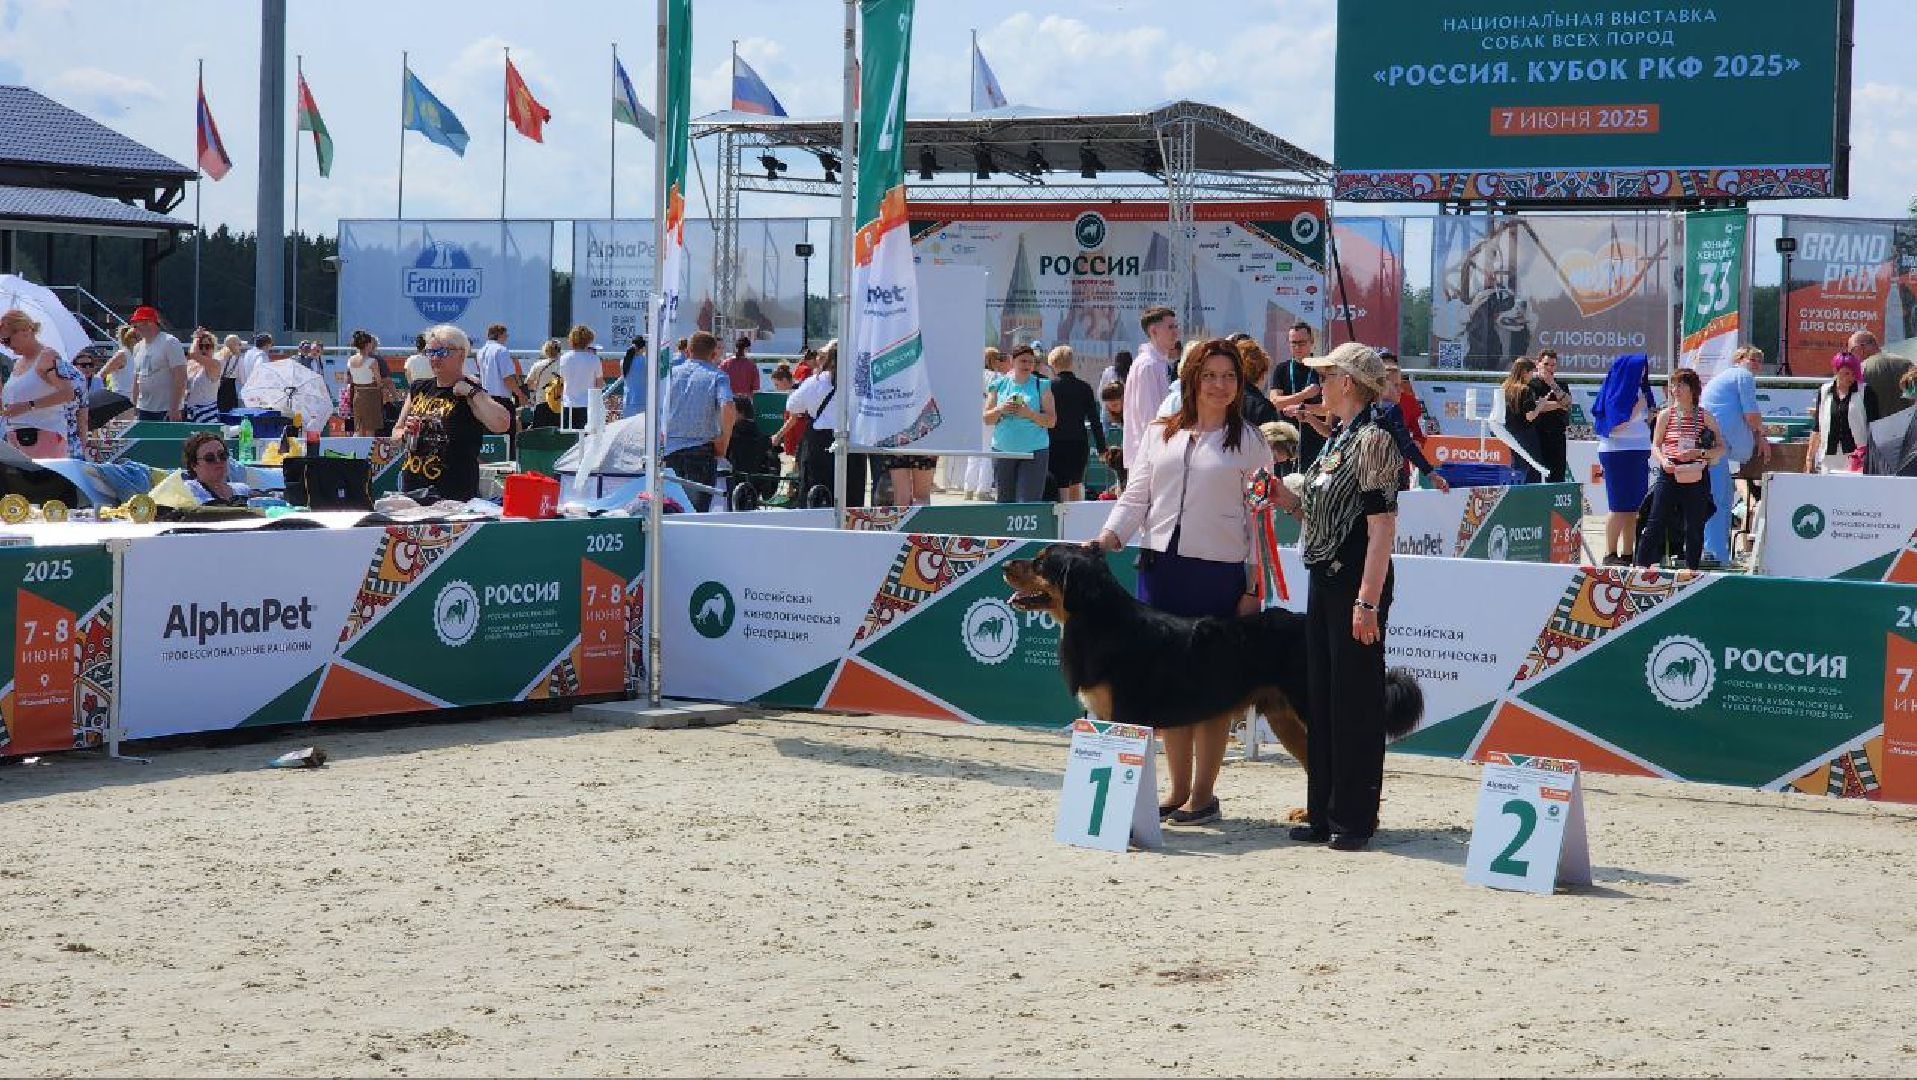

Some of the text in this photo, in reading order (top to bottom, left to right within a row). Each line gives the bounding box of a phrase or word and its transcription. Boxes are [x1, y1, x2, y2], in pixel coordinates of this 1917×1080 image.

[1444, 9, 1717, 31] НАЦИОНАЛЬНАЯ ВЫСТАВКА
[1481, 31, 1675, 49] СОБАК ВСЕХ ПОРОД
[1373, 54, 1801, 86] «РОССИЯ. КУБОК РКФ 2025»
[1502, 109, 1648, 128] 7 ИЮНЯ 2025
[587, 240, 656, 262] AlphaPe
[1801, 232, 1886, 262] GRAND
[1040, 256, 1139, 275] РОССИЯ
[408, 271, 477, 293] Farmina
[1822, 262, 1879, 292] PRIX
[1698, 260, 1731, 314] 33
[1800, 307, 1877, 321] СУХОЙ КОРМ
[1800, 321, 1868, 333] ДЛЯ СОБАК
[1538, 331, 1646, 347] С ЛЮБОВЬЮ
[1452, 449, 1500, 462] РОССИЯ
[1007, 515, 1037, 532] 2025
[587, 533, 624, 552] 2025
[23, 560, 73, 582] 2025
[484, 582, 560, 606] РОССИЯ
[744, 587, 812, 604] Российская
[163, 597, 313, 645] AlphaPet
[743, 610, 841, 625] кинологическая
[743, 624, 809, 642] федерация
[1386, 625, 1464, 640] оссийская
[22, 648, 69, 664] ИЮНЯ
[1386, 645, 1497, 663] инологическая
[1724, 647, 1847, 679] РОССИЯ
[1088, 766, 1113, 838] 1
[1489, 799, 1538, 877] 2
